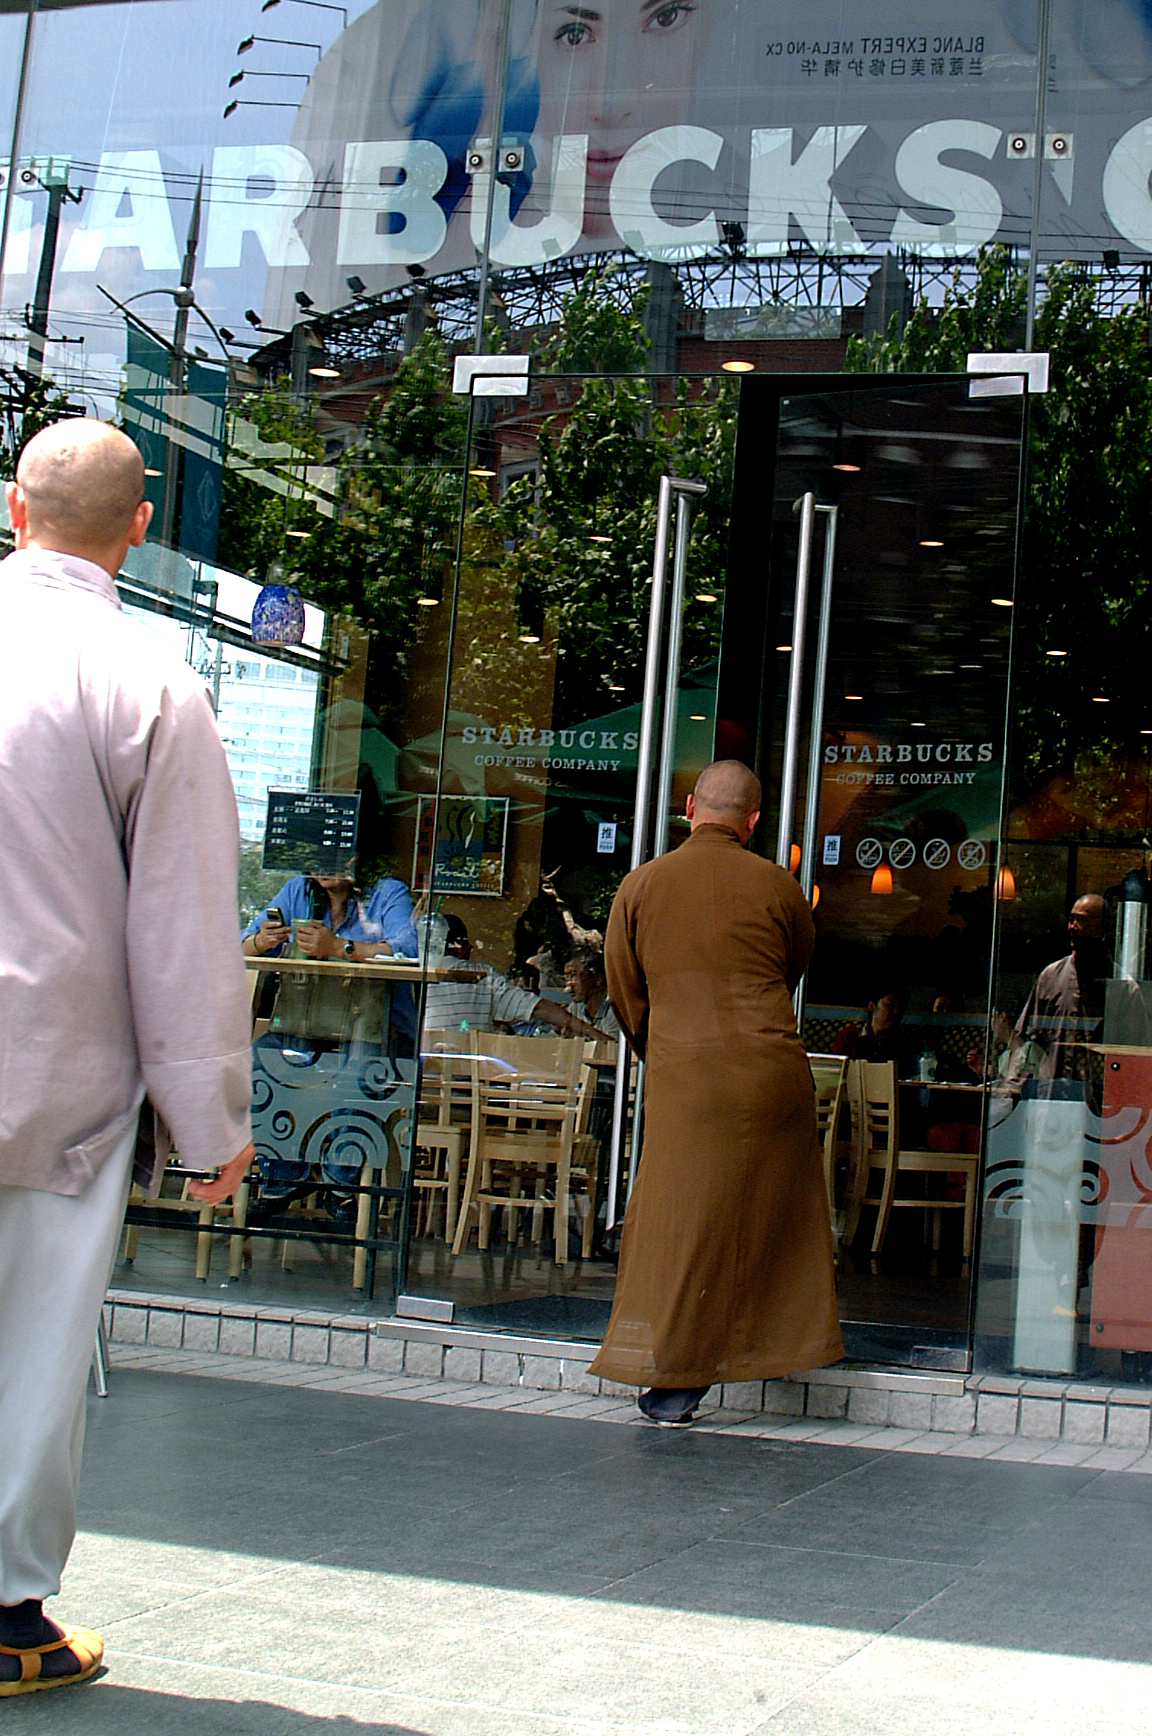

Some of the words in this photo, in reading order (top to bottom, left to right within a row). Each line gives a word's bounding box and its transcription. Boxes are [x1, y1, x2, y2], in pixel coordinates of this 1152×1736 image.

[461, 726, 639, 751] STARBUCKS
[824, 742, 993, 764] STARBUCKS
[474, 755, 536, 769] COFFEE
[541, 757, 621, 771] COMPANY
[836, 773, 894, 785] COFFEE
[899, 772, 976, 785] COMPANY
